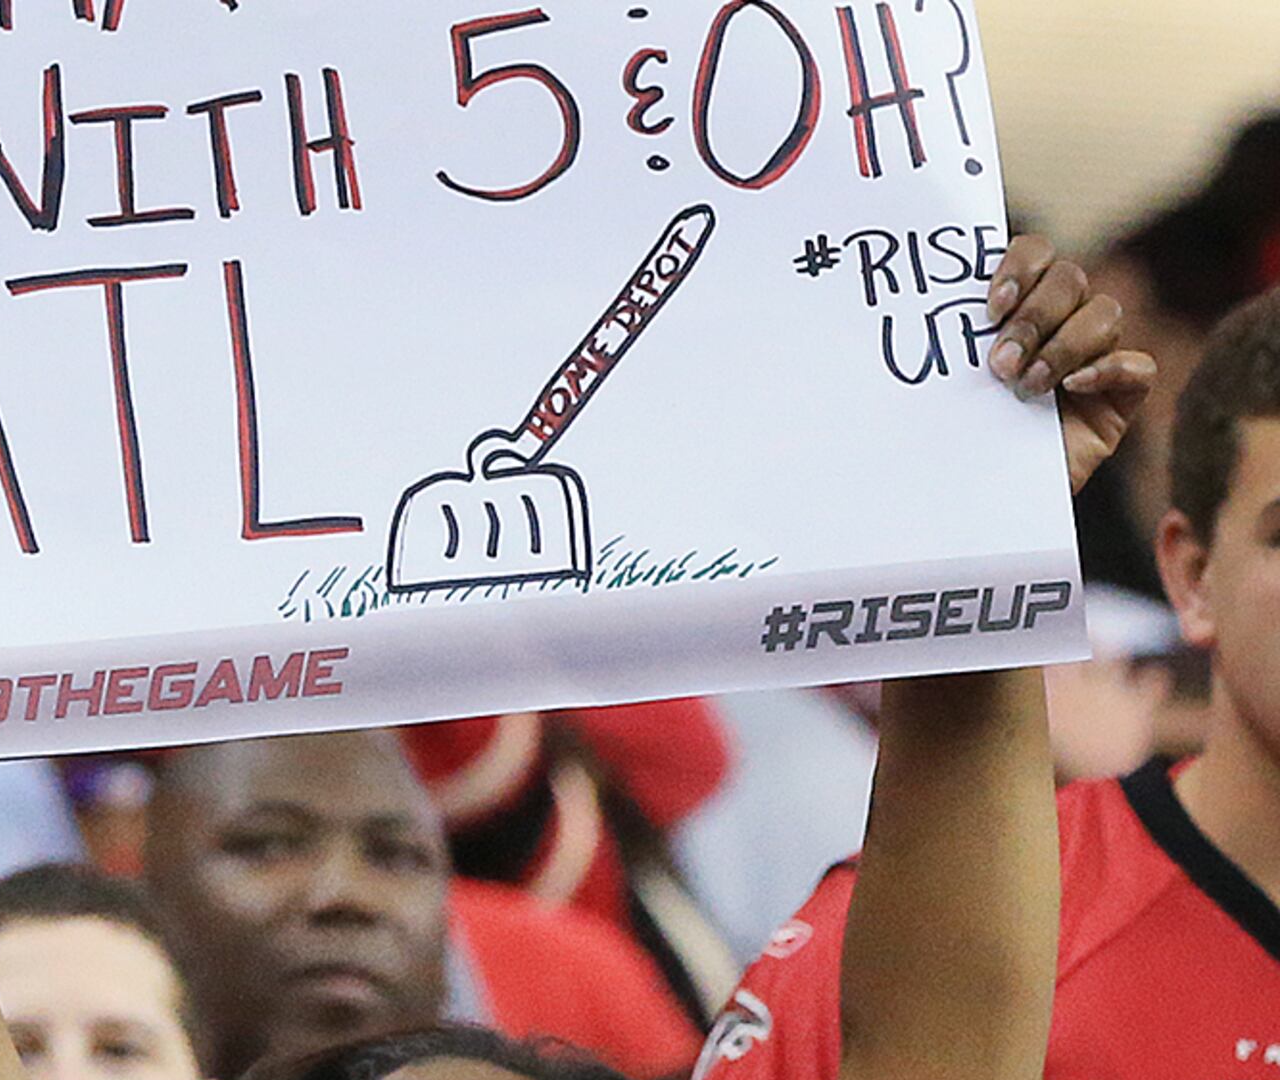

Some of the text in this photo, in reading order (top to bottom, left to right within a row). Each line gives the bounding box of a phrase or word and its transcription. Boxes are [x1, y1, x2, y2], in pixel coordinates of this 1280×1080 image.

[436, 8, 581, 202] 5
[526, 227, 697, 441] HOME DEPOT
[793, 225, 1007, 306] #RISE
[761, 579, 1073, 652] #RISEUP
